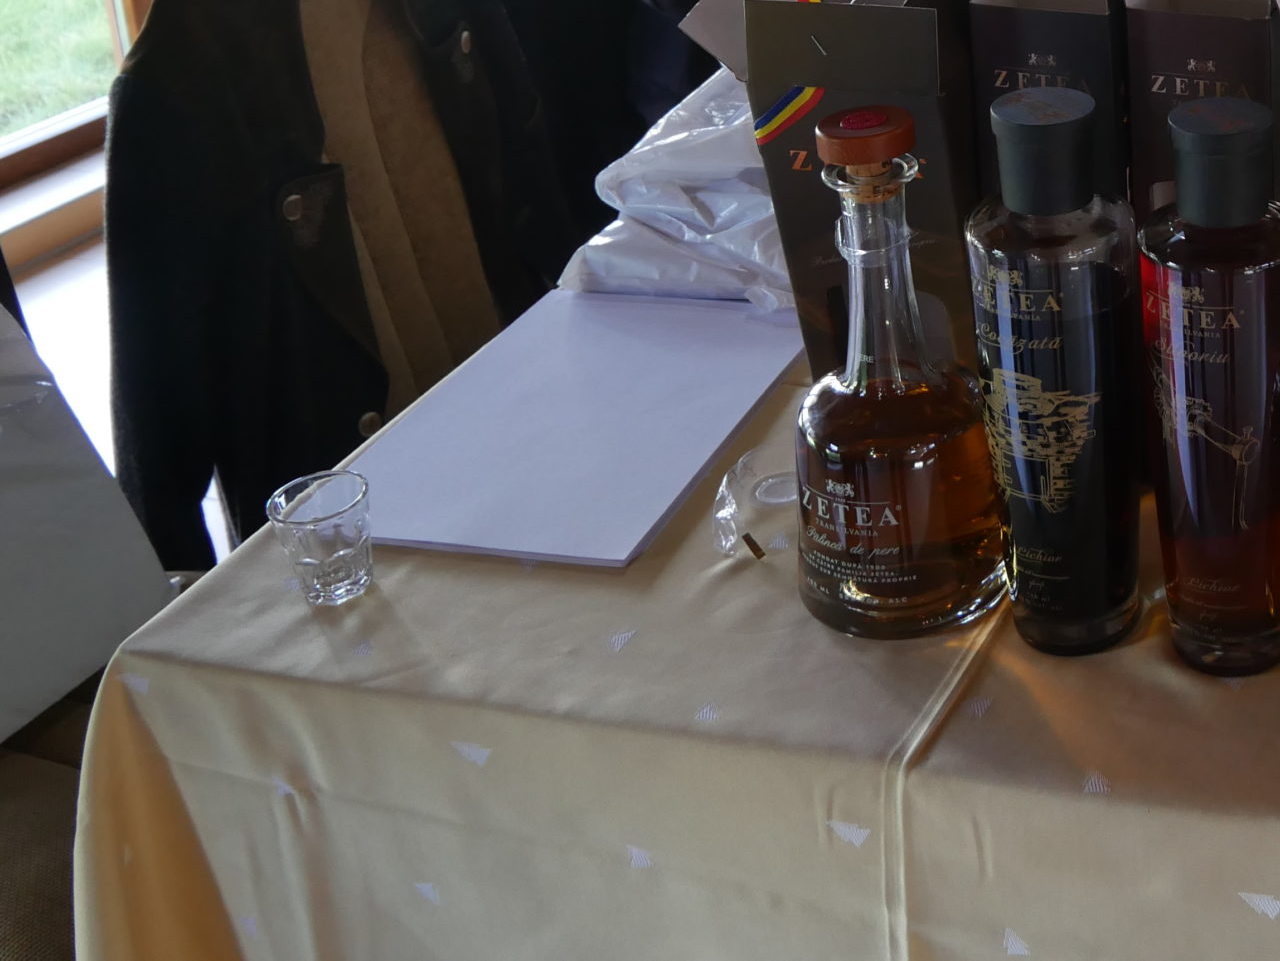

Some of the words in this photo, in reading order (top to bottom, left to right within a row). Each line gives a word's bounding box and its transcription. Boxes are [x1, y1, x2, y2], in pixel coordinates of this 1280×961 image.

[992, 69, 1092, 94] ZETEA
[1151, 75, 1250, 99] ZETEA
[973, 280, 1061, 311] ETEA
[1146, 291, 1240, 330] ZETEA
[857, 353, 874, 364] ERE
[802, 485, 900, 527] ZETEA
[849, 542, 864, 555] de
[868, 545, 900, 559] pere
